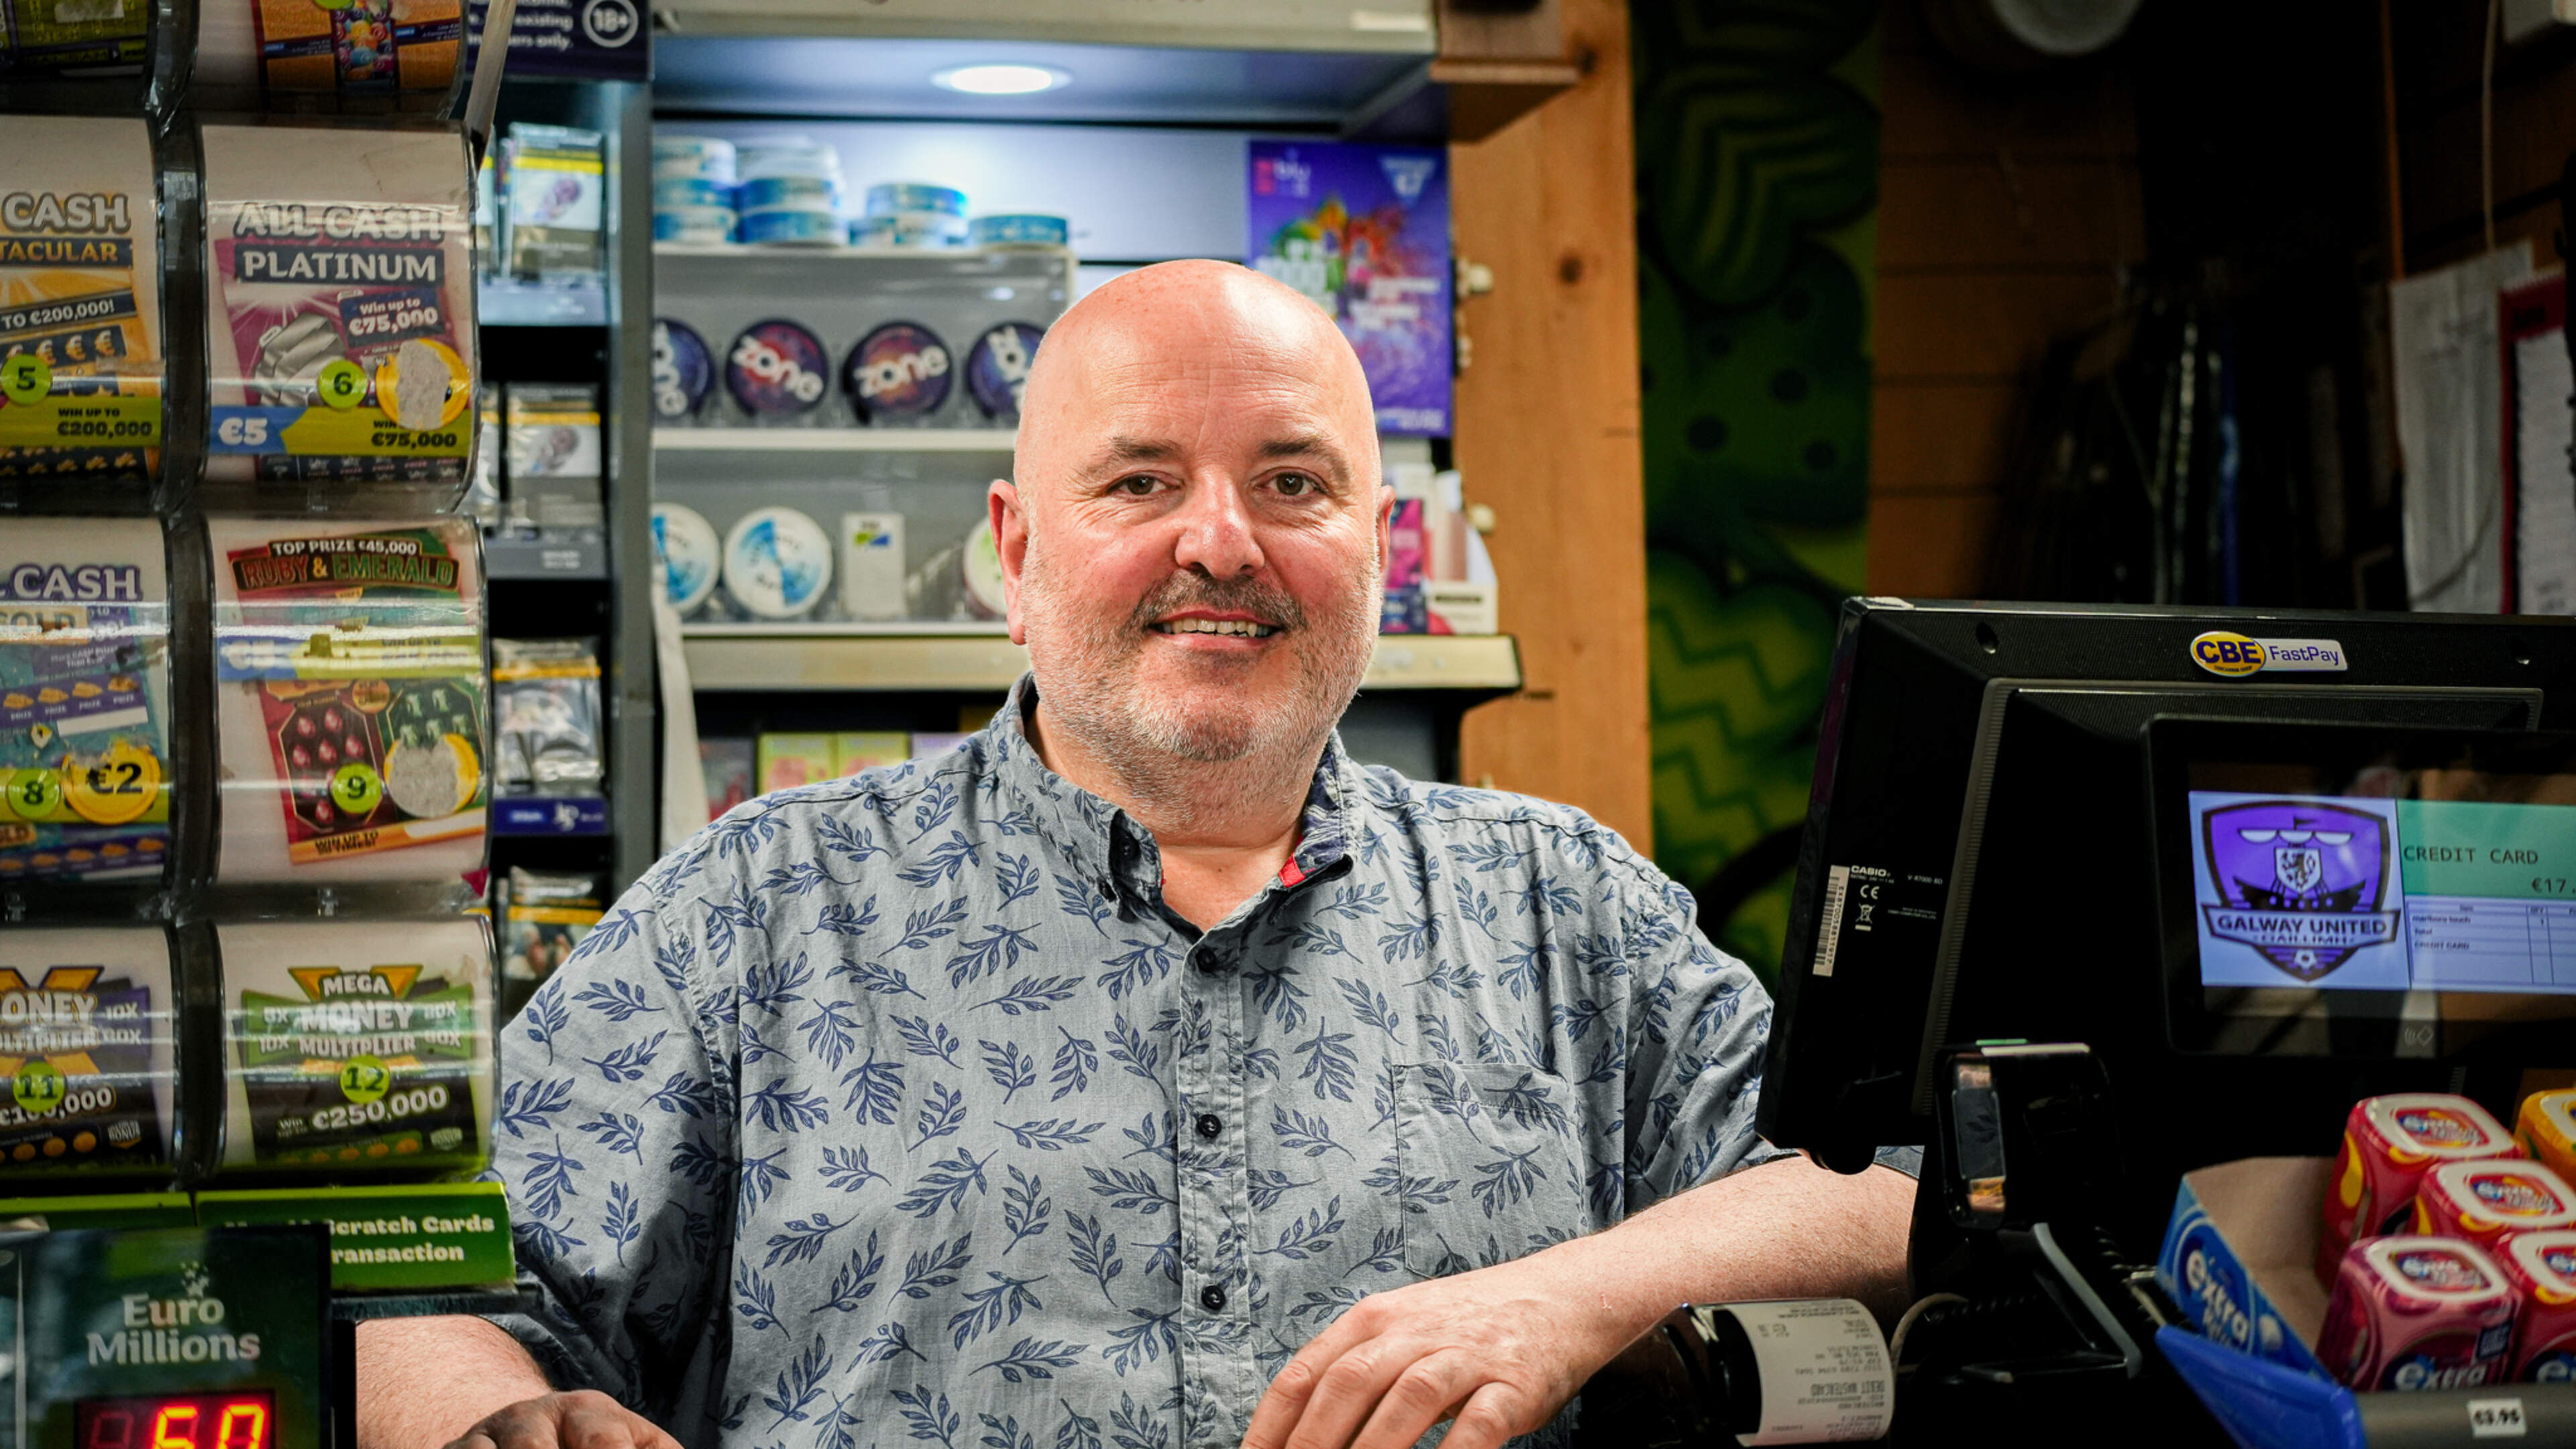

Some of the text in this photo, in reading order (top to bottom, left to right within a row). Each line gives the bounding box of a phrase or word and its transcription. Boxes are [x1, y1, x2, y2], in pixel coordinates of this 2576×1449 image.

[3, 193, 130, 233] CASH
[234, 202, 445, 245] ALL CASH
[242, 250, 437, 282] PLATINUM
[1, 298, 115, 329] TO €200,000!
[359, 297, 421, 316] Win up to
[349, 306, 439, 336] €75,000
[16, 366, 36, 391] 5
[732, 333, 825, 404] zone
[853, 345, 950, 399] zone
[333, 372, 353, 396] 6
[58, 407, 120, 417] WIN UP TO
[57, 421, 153, 439] €200,000
[218, 417, 268, 446] €5
[370, 431, 458, 450] €75,000
[272, 539, 417, 556] TOP PRIZE €45,000
[13, 568, 138, 601] CASH
[241, 555, 454, 589] RUBY & EMERALD
[2196, 641, 2339, 666] CBE FastPay
[86, 763, 143, 794] €2
[347, 775, 366, 800] 9
[23, 781, 44, 805] 8
[2404, 845, 2539, 865] CREDIT CARD
[1851, 864, 1887, 877] CASIO
[2217, 914, 2387, 935] GALWAY UNITED
[322, 975, 390, 998] MEGA
[299, 1001, 414, 1032] MONEY
[299, 1035, 417, 1058] MULTIPLIER
[18, 1074, 58, 1099] 11
[344, 1067, 384, 1091] 12
[311, 1085, 449, 1130] €250,000
[279, 1118, 303, 1130] Win
[422, 1214, 495, 1234] Cards
[331, 1241, 465, 1265] ransaction
[121, 1291, 225, 1328] Euro
[2186, 1249, 2250, 1346] extra
[86, 1328, 262, 1366] Millions
[2394, 1362, 2487, 1389] extra
